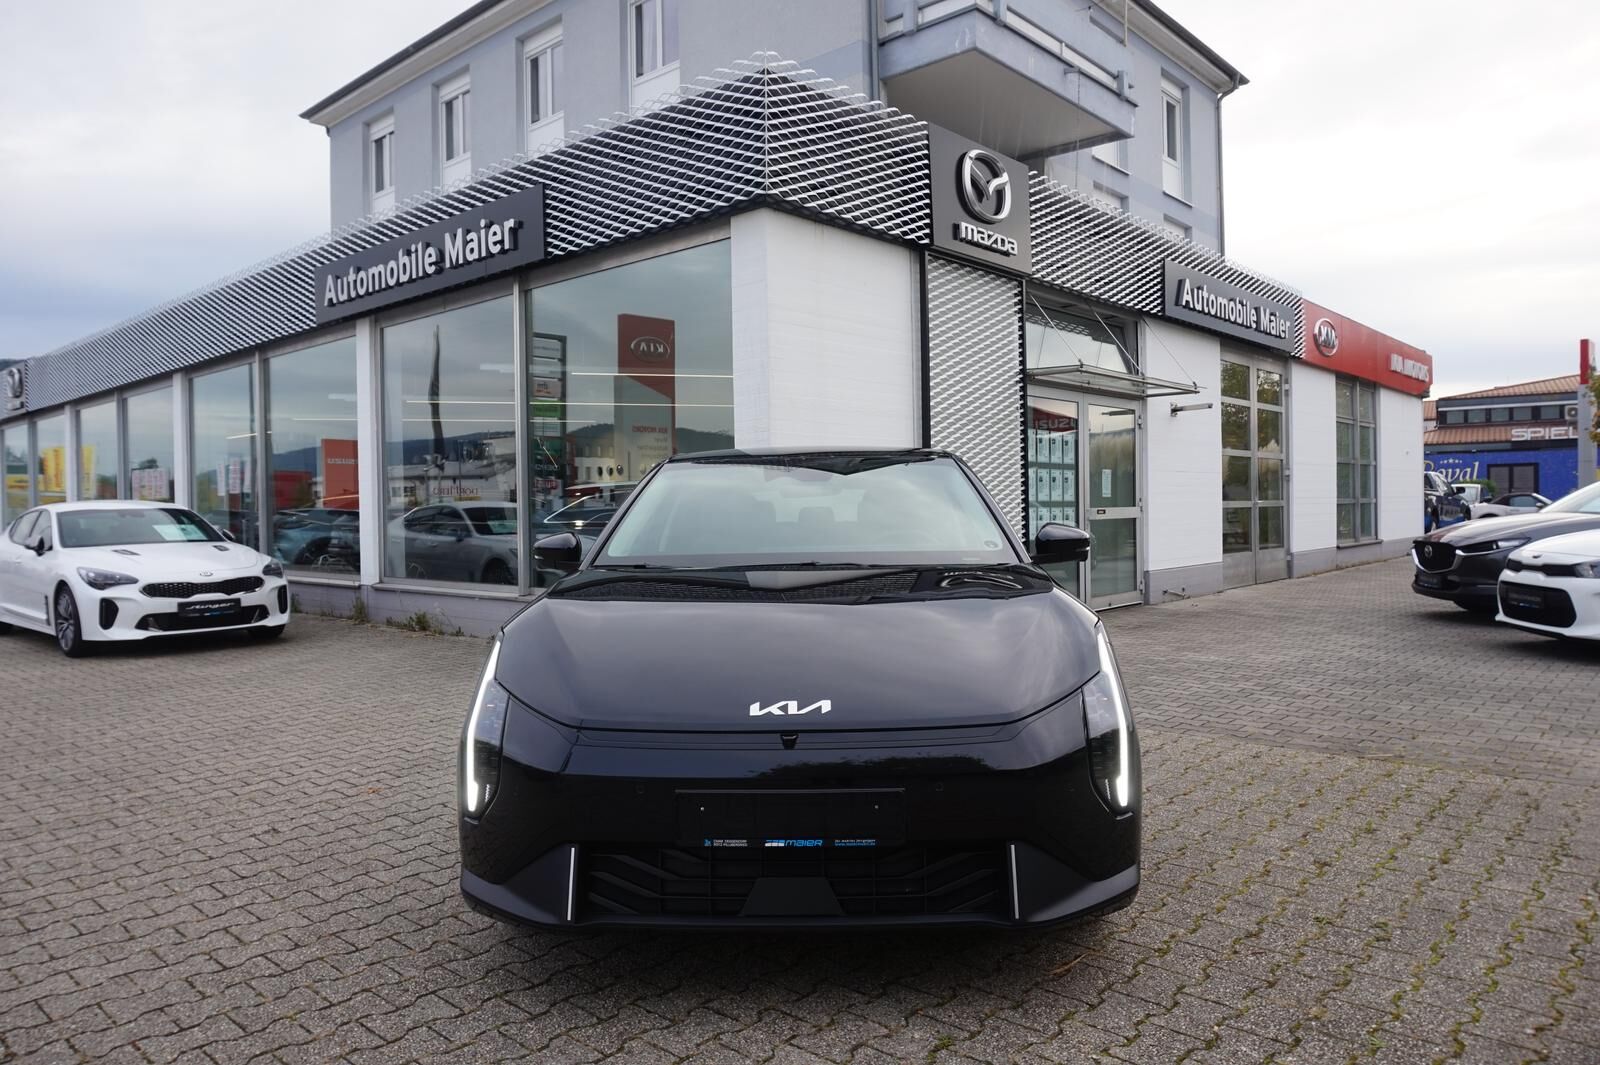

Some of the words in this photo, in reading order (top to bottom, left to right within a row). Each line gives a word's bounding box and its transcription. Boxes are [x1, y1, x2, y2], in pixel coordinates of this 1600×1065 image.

[323, 241, 437, 307] Automobile
[444, 217, 517, 268] Maier
[959, 221, 1018, 256] mazda
[1180, 278, 1257, 329] Automobile
[1259, 304, 1291, 340] Maier
[749, 699, 832, 717] KIA
